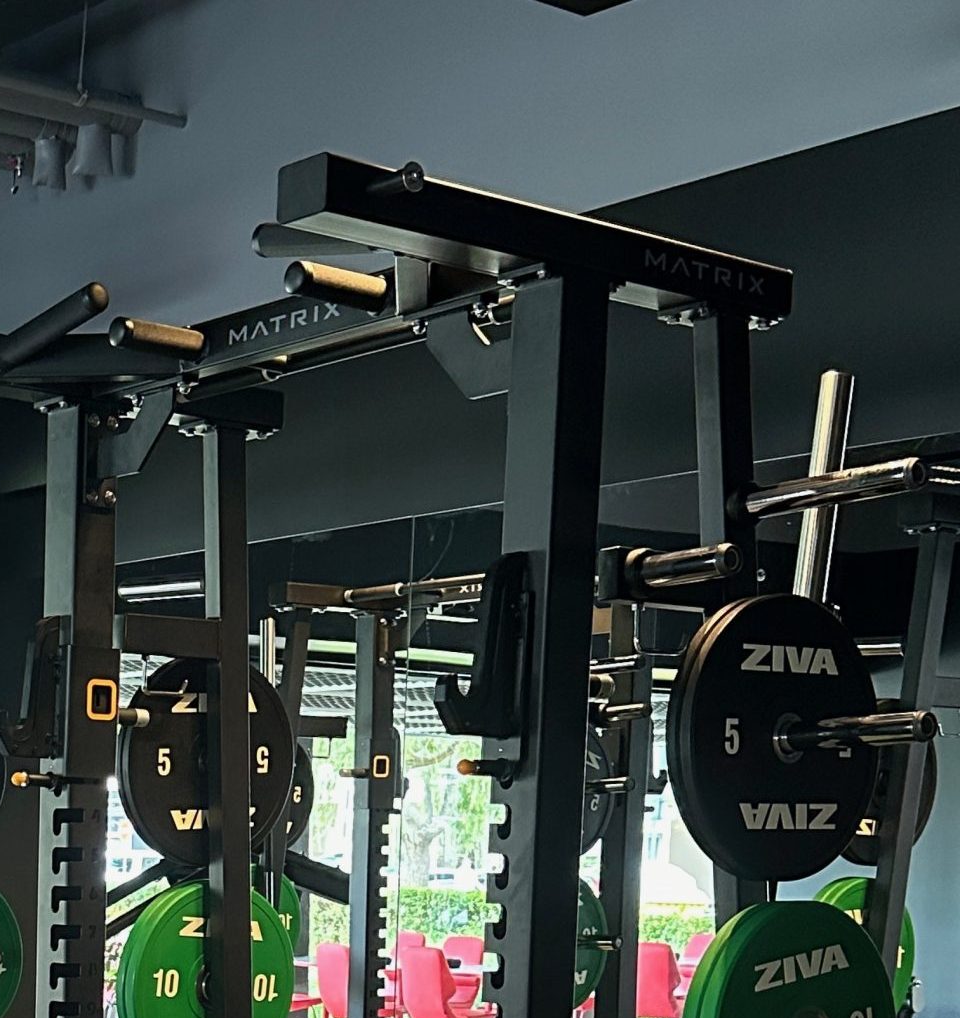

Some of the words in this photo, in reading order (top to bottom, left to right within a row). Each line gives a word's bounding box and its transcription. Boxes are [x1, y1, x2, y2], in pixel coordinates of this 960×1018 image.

[644, 249, 765, 296] MATRIX
[228, 302, 340, 346] MATRIX
[741, 643, 839, 676] ZIVA
[725, 717, 740, 755] 5
[157, 748, 171, 776] 5
[256, 746, 269, 774] 5
[739, 803, 838, 831] ZIVA
[178, 916, 263, 941] ZA
[153, 968, 180, 998] 10
[754, 944, 849, 993] ZIVA
[253, 973, 279, 1002] 10
